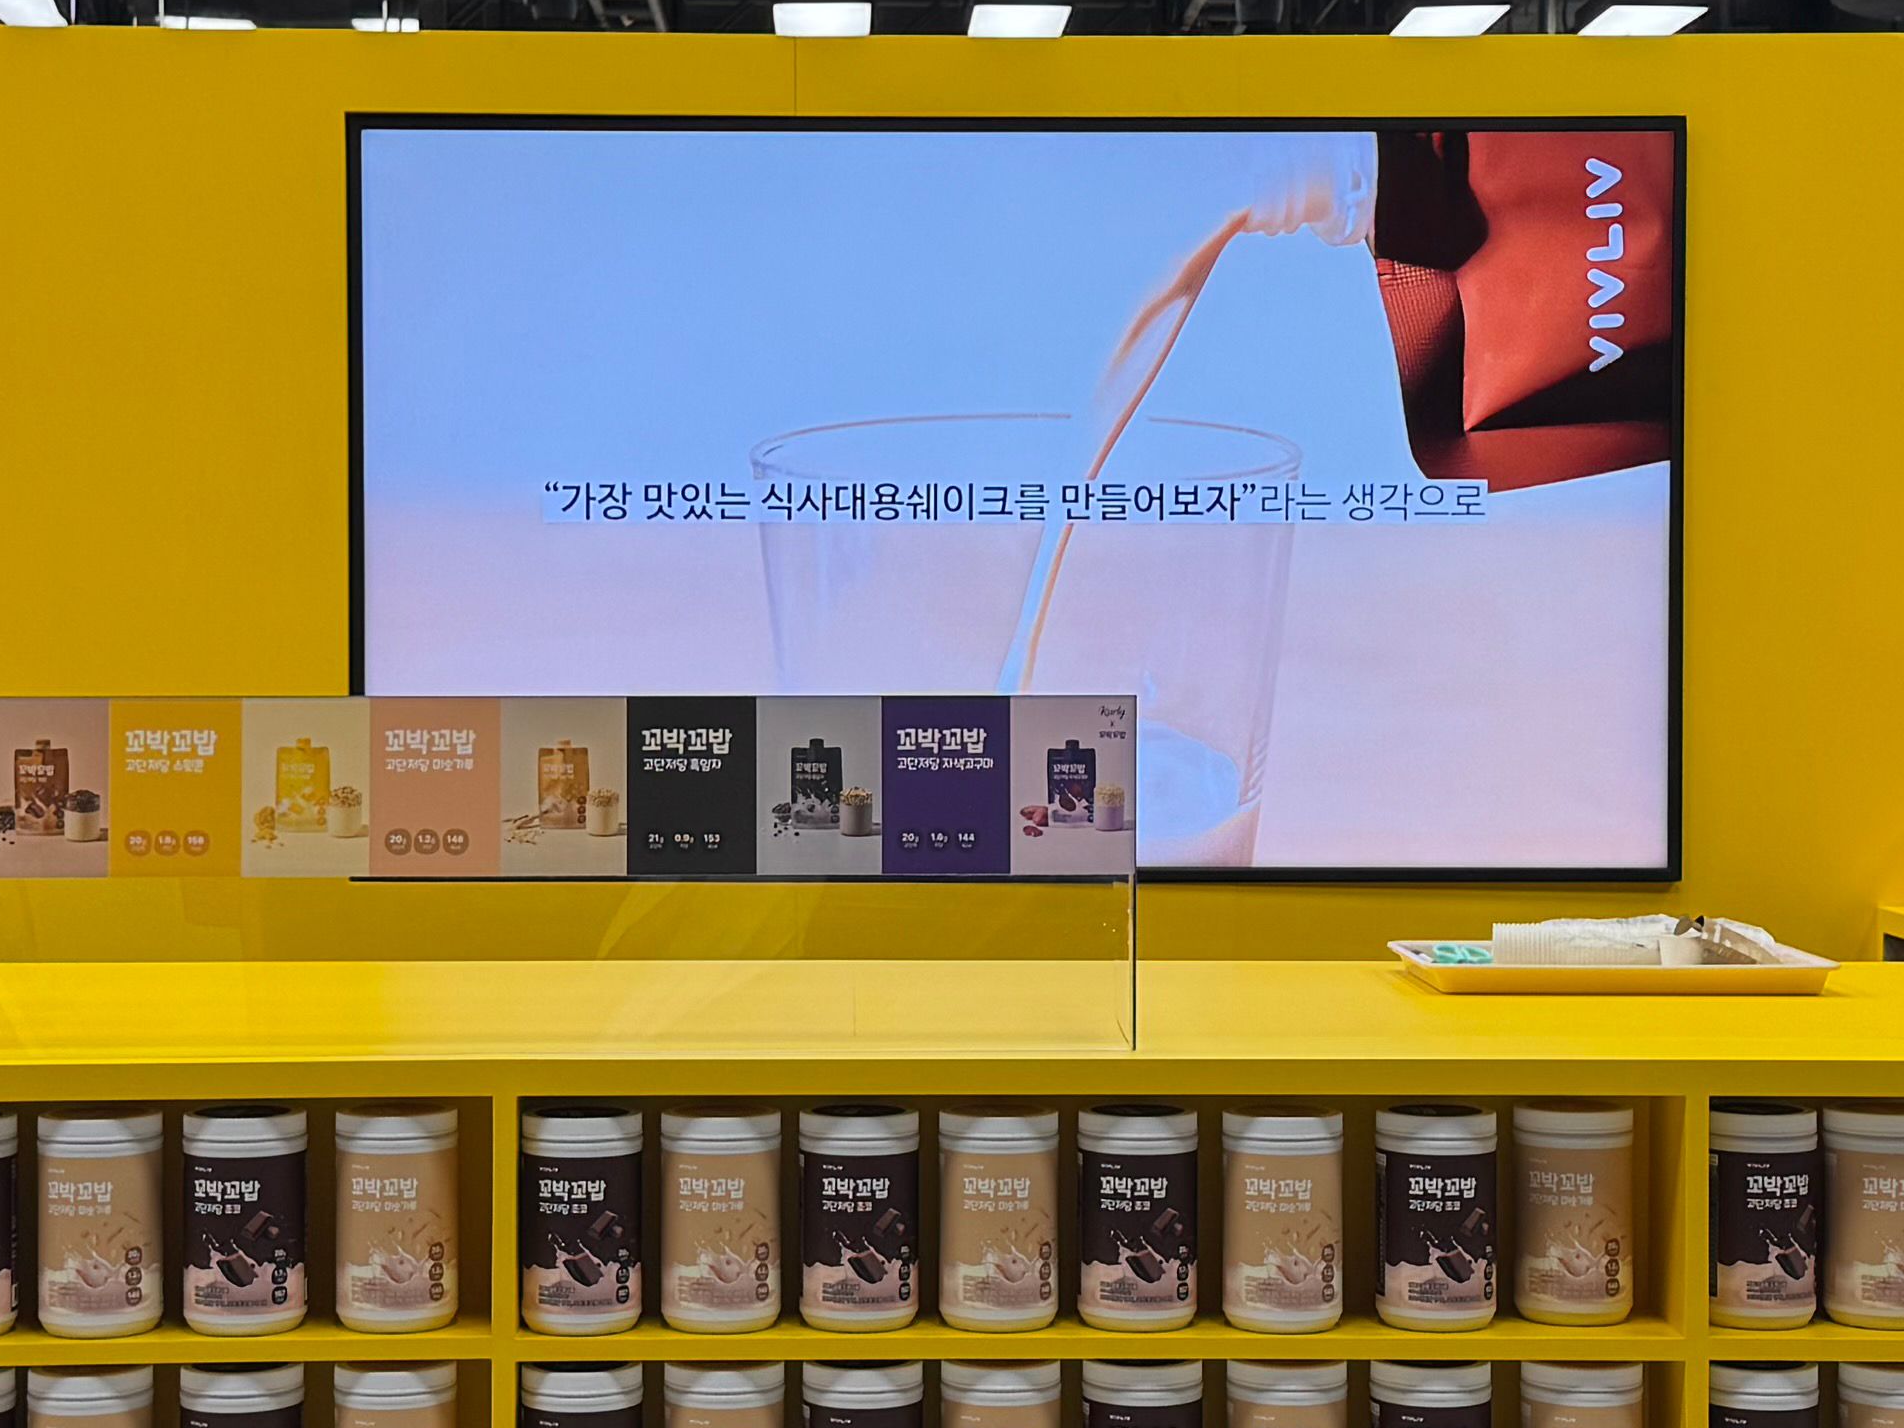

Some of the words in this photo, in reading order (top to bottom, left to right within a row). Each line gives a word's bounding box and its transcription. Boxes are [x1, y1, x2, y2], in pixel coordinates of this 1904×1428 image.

[1584, 156, 1627, 374] VIVLIV
[643, 482, 751, 521] 맛있는
[760, 481, 1050, 521] 식사대용쉐이크를
[1341, 482, 1486, 522] 생각으로
[124, 729, 218, 756] 꼬박꼬밥
[384, 729, 477, 756] 꼬박꼬밥
[641, 728, 733, 755] 꼬박꼬밥
[896, 727, 987, 755] 꼬박꼬밥
[643, 758, 687, 772] 고단저당
[897, 757, 940, 771] 고단저당
[942, 757, 994, 771] 자색고구마
[703, 834, 721, 843] 153
[958, 833, 975, 842] 144
[680, 1178, 744, 1199] 꼬박꼬밥
[1245, 1178, 1312, 1200] 꼬박꼬밥
